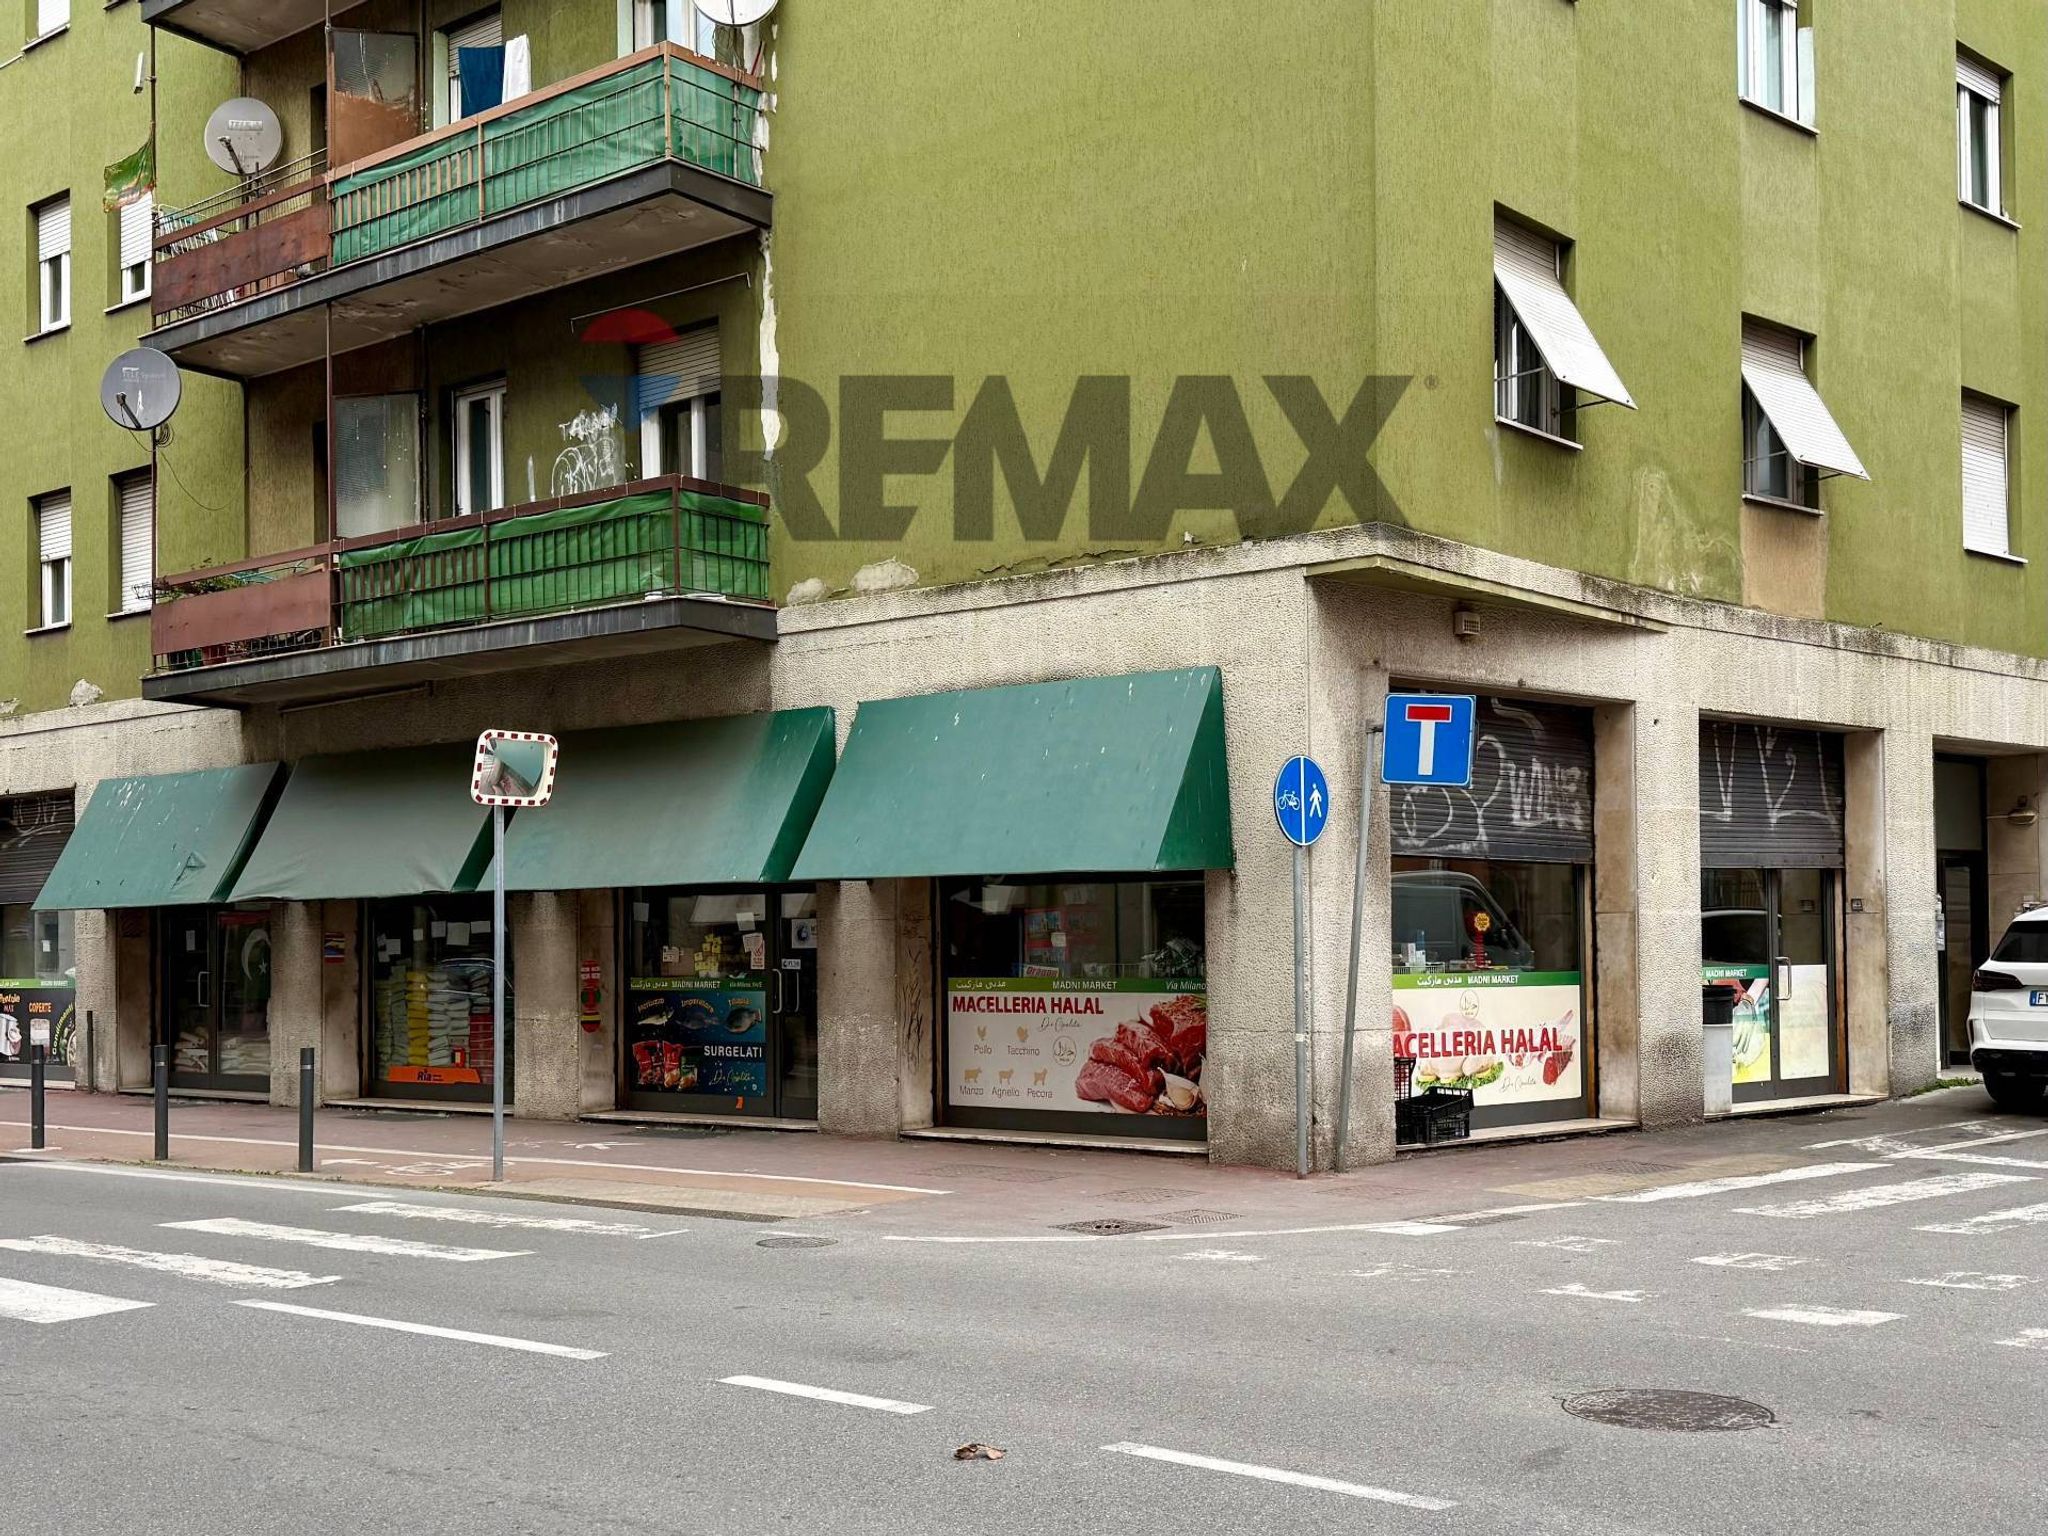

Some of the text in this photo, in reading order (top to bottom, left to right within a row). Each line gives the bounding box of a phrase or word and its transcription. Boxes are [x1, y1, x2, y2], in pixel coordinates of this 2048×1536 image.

[1467, 974, 1519, 984] MADNI MARKET
[694, 981, 720, 989] MARKET
[1052, 981, 1118, 990] MADNI MARKET
[1165, 981, 1178, 990] Via
[952, 996, 1104, 1014] MACELLERIA HALAL
[1501, 1027, 1563, 1053] HALAL
[704, 1045, 762, 1058] SURGELATI
[973, 1044, 992, 1055] Pollo
[1007, 1045, 1040, 1056] Tacchino
[960, 1086, 984, 1095] Manzo
[991, 1086, 1020, 1099] Agnello
[1027, 1088, 1053, 1099] Pecora
